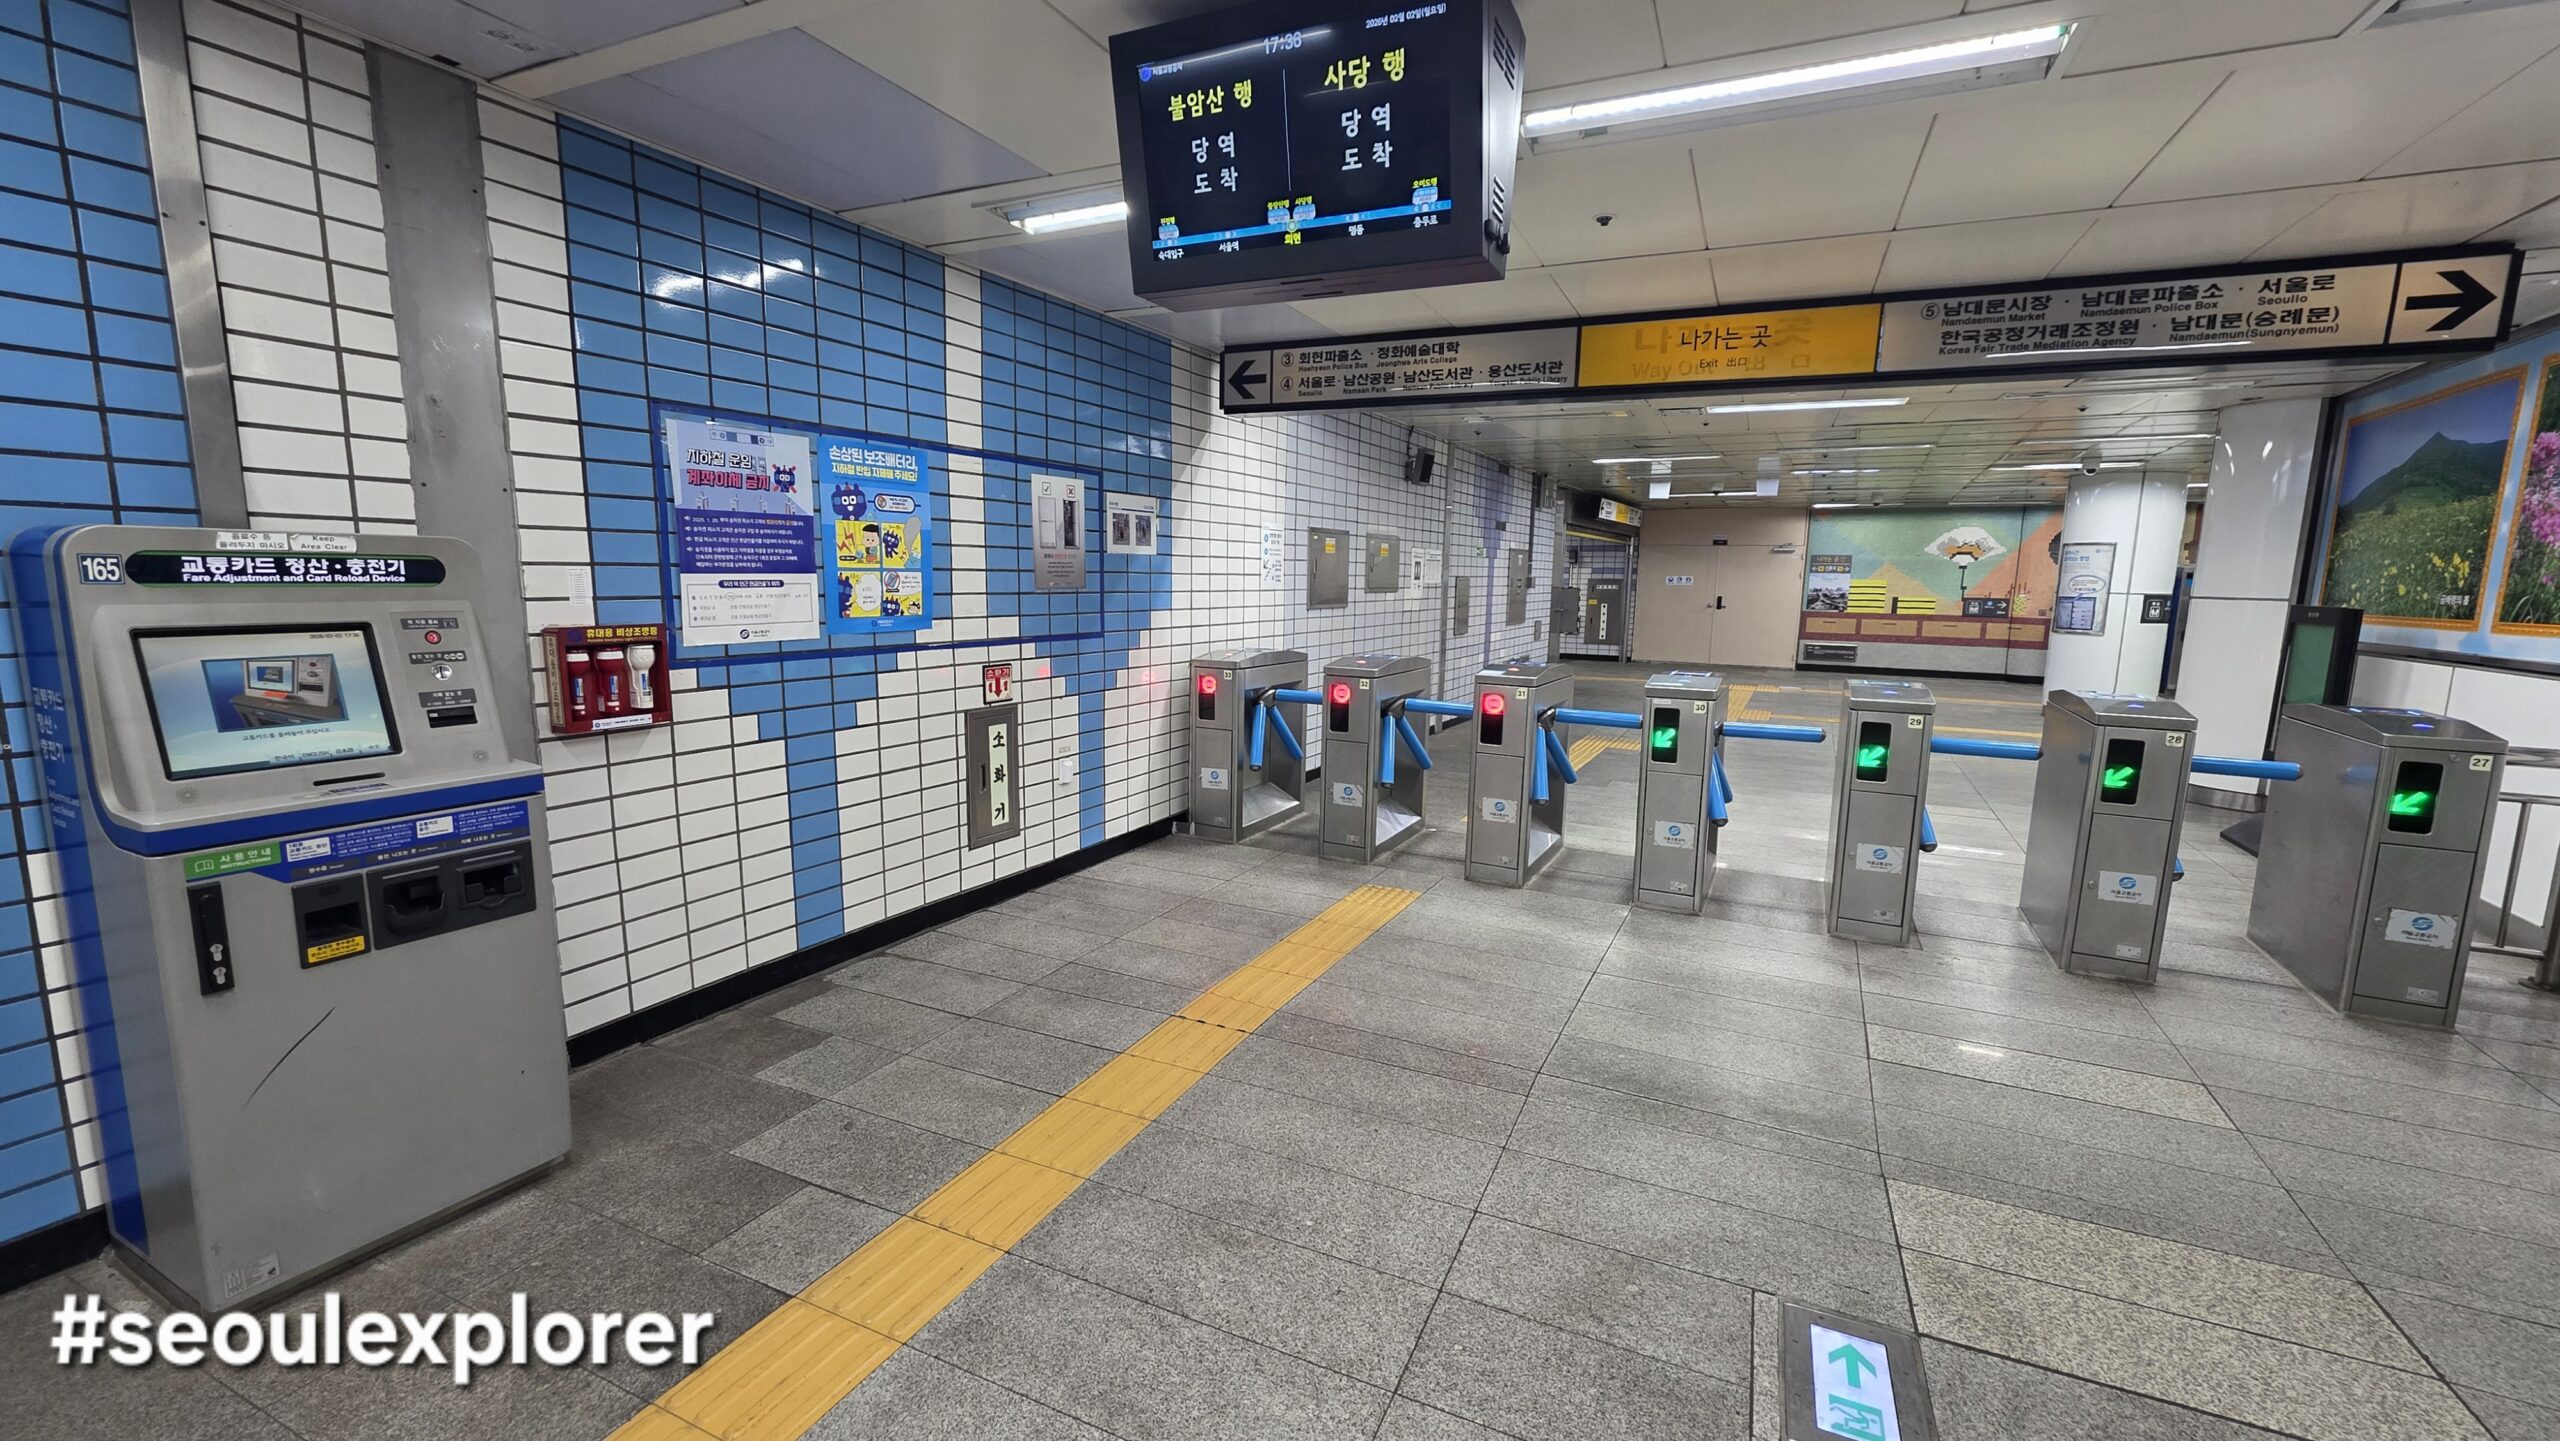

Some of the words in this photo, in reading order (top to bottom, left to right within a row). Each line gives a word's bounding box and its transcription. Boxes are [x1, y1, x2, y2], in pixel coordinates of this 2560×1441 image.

[1263, 32, 1302, 55] 17:36
[1324, 55, 1371, 91] 사당
[1381, 47, 1406, 83] 행
[1167, 84, 1225, 122] 불암산
[1232, 79, 1253, 110] 행
[1294, 195, 1313, 206] 사당행
[1412, 214, 1438, 228] 충무로
[1348, 223, 1364, 237] 명동
[1284, 232, 1302, 246] 회현
[1218, 241, 1240, 253] 서울역
[1158, 248, 1184, 261] 숙대입구
[1943, 295, 2053, 318] 남대문시장
[2081, 282, 2224, 308] 남대문파출소
[2258, 274, 2337, 295] 서울로
[1940, 314, 2006, 327] Namdaemun
[2008, 312, 2046, 322] Market
[2080, 304, 2150, 318] Namdaemun
[2154, 302, 2192, 314] Police
[2195, 300, 2219, 310] Box
[2258, 295, 2308, 306] Seoullo
[1940, 318, 2141, 346] 한국공정거래조정원
[2170, 306, 2340, 332] 남대문(숭례문)
[1680, 326, 1744, 352] 나가는
[1750, 325, 1772, 348] 곳
[1938, 345, 1970, 356] Korea
[1974, 344, 1996, 354] Fair
[1999, 342, 2030, 352] Trade
[2033, 339, 2090, 350] Mediation
[2092, 337, 2136, 348] Agency
[2169, 323, 2340, 344] Namdaemun(Sungnyemun)
[1299, 348, 1362, 364] 회현파출소
[1377, 341, 1460, 359] 정화예술대학
[1376, 358, 1411, 368] Jeonghwa
[1413, 357, 1428, 366] Arts
[1430, 356, 1458, 364] College
[1699, 358, 1718, 368] Exit
[1726, 356, 1748, 368] 出口
[1298, 374, 1336, 389] 서울로
[1343, 371, 1396, 386] 남산공원
[1403, 366, 1474, 382] 남산도서관
[1488, 360, 1564, 378] 용산도서관
[686, 448, 726, 467] 지하철
[728, 453, 753, 470] 운임
[829, 445, 862, 463] 손상된
[864, 450, 918, 472] 보조배터리,
[832, 462, 855, 475] 지하철
[856, 466, 872, 477] 반입
[686, 468, 742, 489] 계좌이체
[746, 474, 771, 492] 금지
[259, 541, 285, 550] 마시오
[312, 534, 336, 543] Keep
[82, 557, 120, 581] 165
[181, 557, 278, 575] 교통카드
[285, 558, 330, 574] 정산
[346, 558, 406, 576] 충전기
[183, 574, 210, 582] Fare
[213, 574, 280, 584] Adjustment
[283, 574, 304, 582] and
[306, 574, 332, 582] Card
[334, 574, 370, 583] Reload
[372, 575, 406, 583] Device
[586, 628, 614, 638] 휴대용
[616, 626, 658, 636] 비상조명등
[986, 668, 1010, 678] 소화기
[1518, 690, 1526, 698] 31
[1694, 704, 1705, 712] 30
[1910, 718, 1922, 726] 29
[2167, 735, 2182, 744] 28
[2472, 758, 2490, 767] 27
[992, 731, 1006, 821] 소화기
